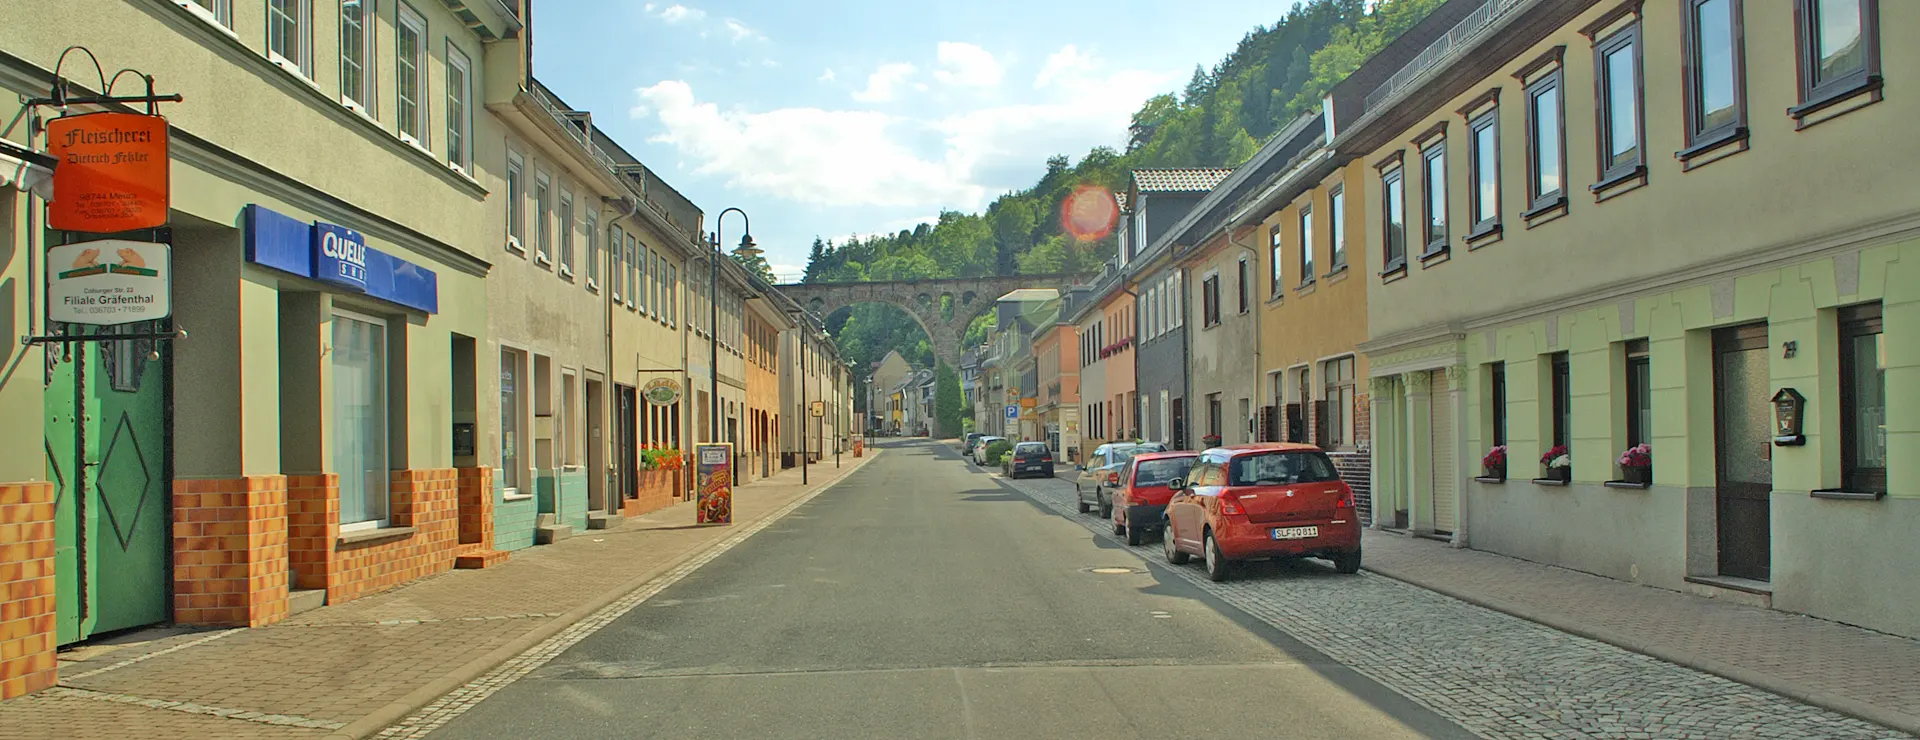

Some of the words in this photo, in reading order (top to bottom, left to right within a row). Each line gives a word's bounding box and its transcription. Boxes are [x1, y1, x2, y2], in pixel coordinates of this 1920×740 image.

[62, 127, 151, 148] Fleischerei
[67, 152, 110, 165] Dietrich
[322, 231, 366, 268] QUELLE
[64, 296, 96, 305] Filiale
[98, 294, 154, 305] Gräfenthal
[1007, 406, 1016, 417] P
[1276, 528, 1291, 538] SLF
